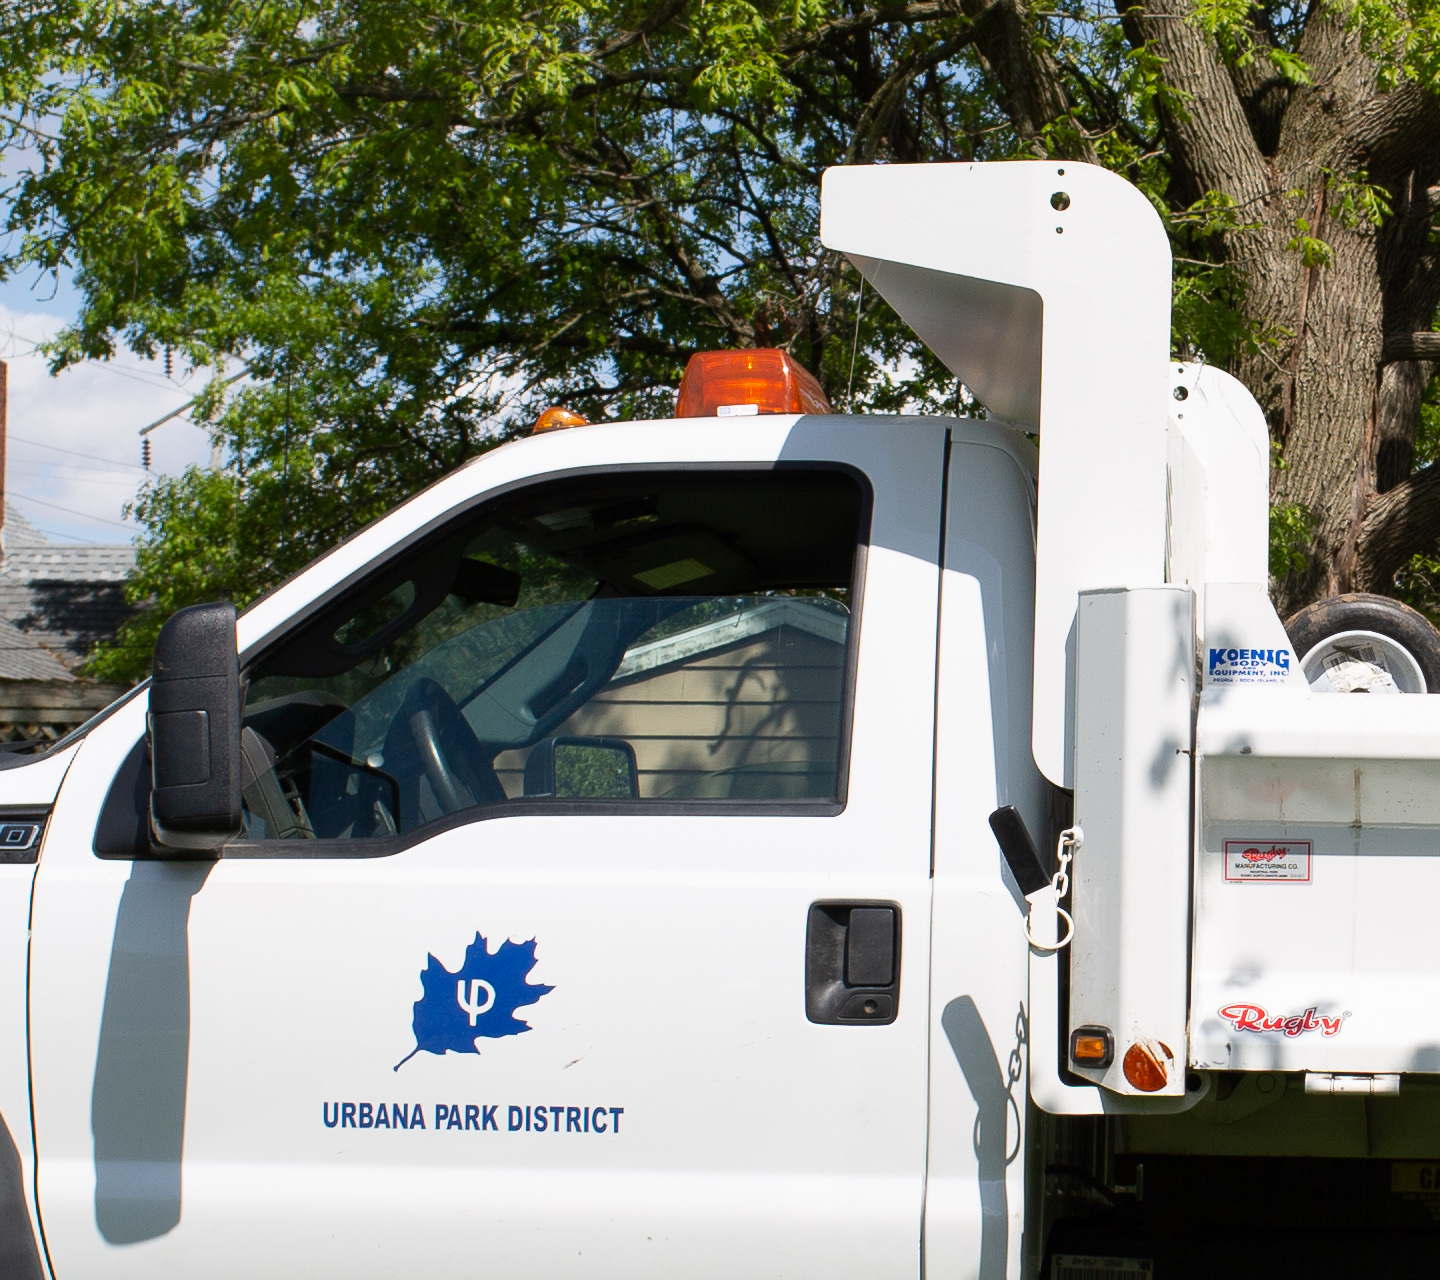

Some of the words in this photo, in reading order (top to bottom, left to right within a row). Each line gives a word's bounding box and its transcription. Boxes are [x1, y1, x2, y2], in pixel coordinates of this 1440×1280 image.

[1209, 648, 1290, 672] KOENIG
[1218, 1003, 1342, 1037] Rugby
[322, 1101, 425, 1130] URBANA
[434, 1104, 498, 1132] PARK
[508, 1106, 624, 1134] DISTRICT
